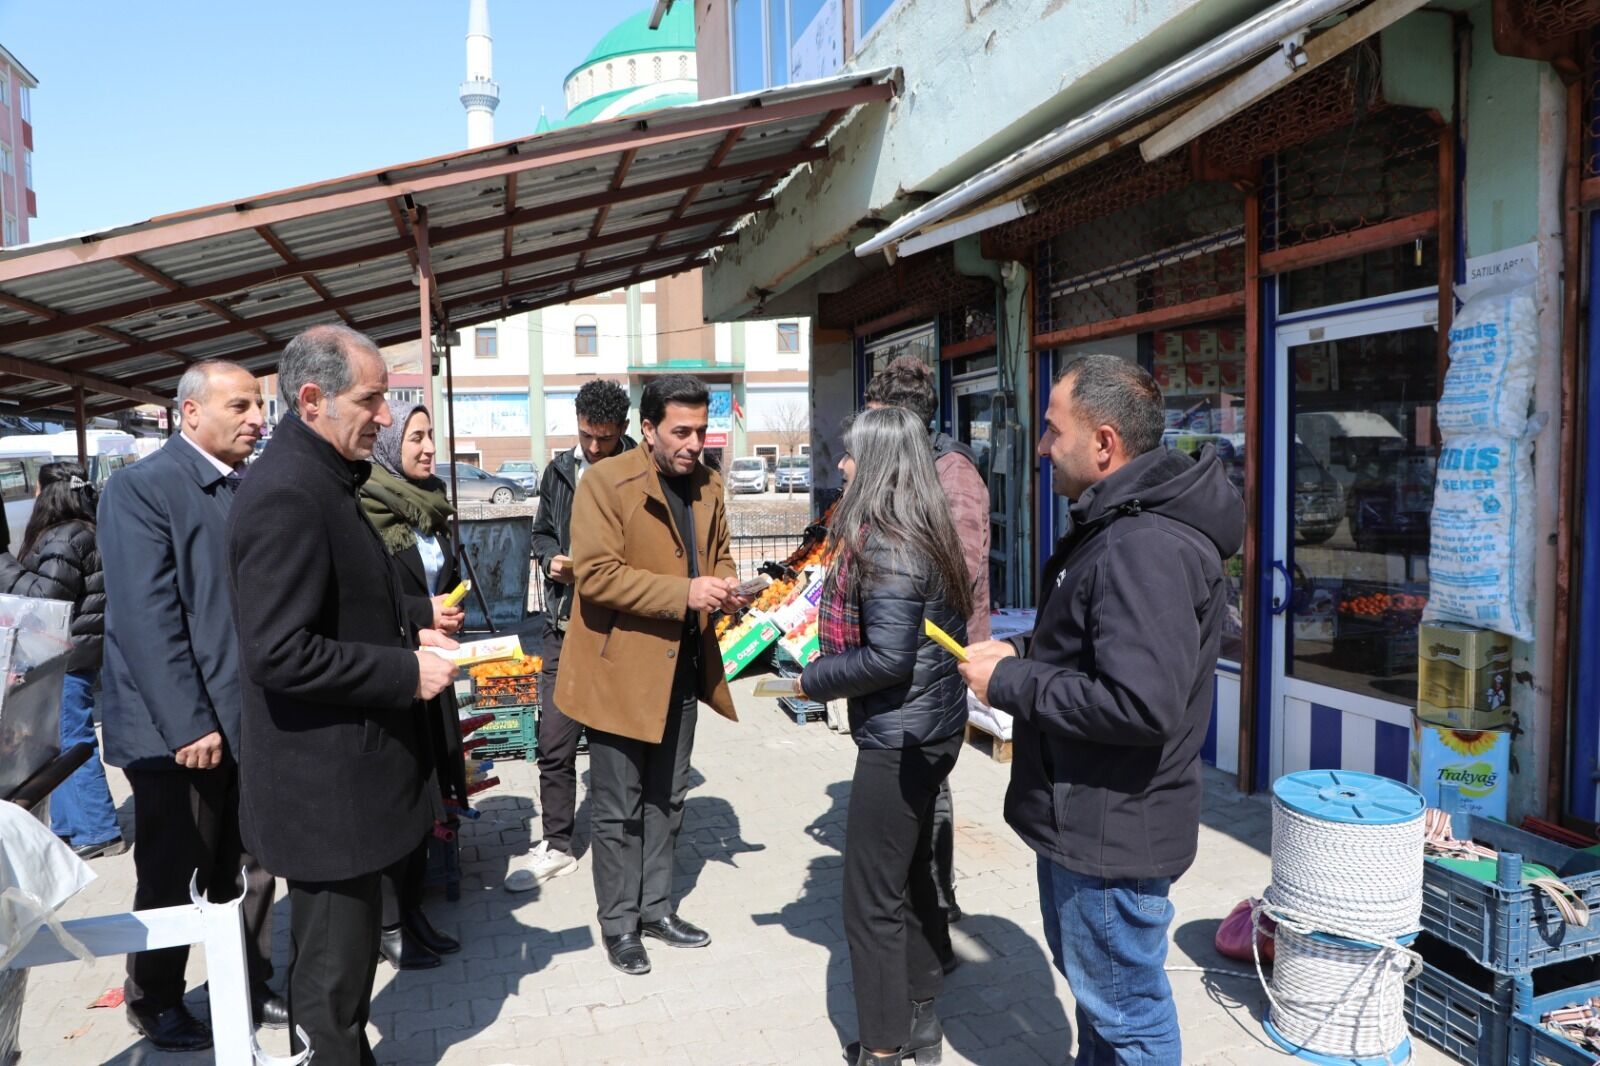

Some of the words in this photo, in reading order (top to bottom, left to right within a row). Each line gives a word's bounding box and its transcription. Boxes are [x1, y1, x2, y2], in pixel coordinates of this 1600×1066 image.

[1471, 262, 1501, 280] SATILIK
[1503, 257, 1525, 272] AR
[1442, 478, 1495, 492] ŞEKER
[1437, 767, 1498, 787] Trakyağ
